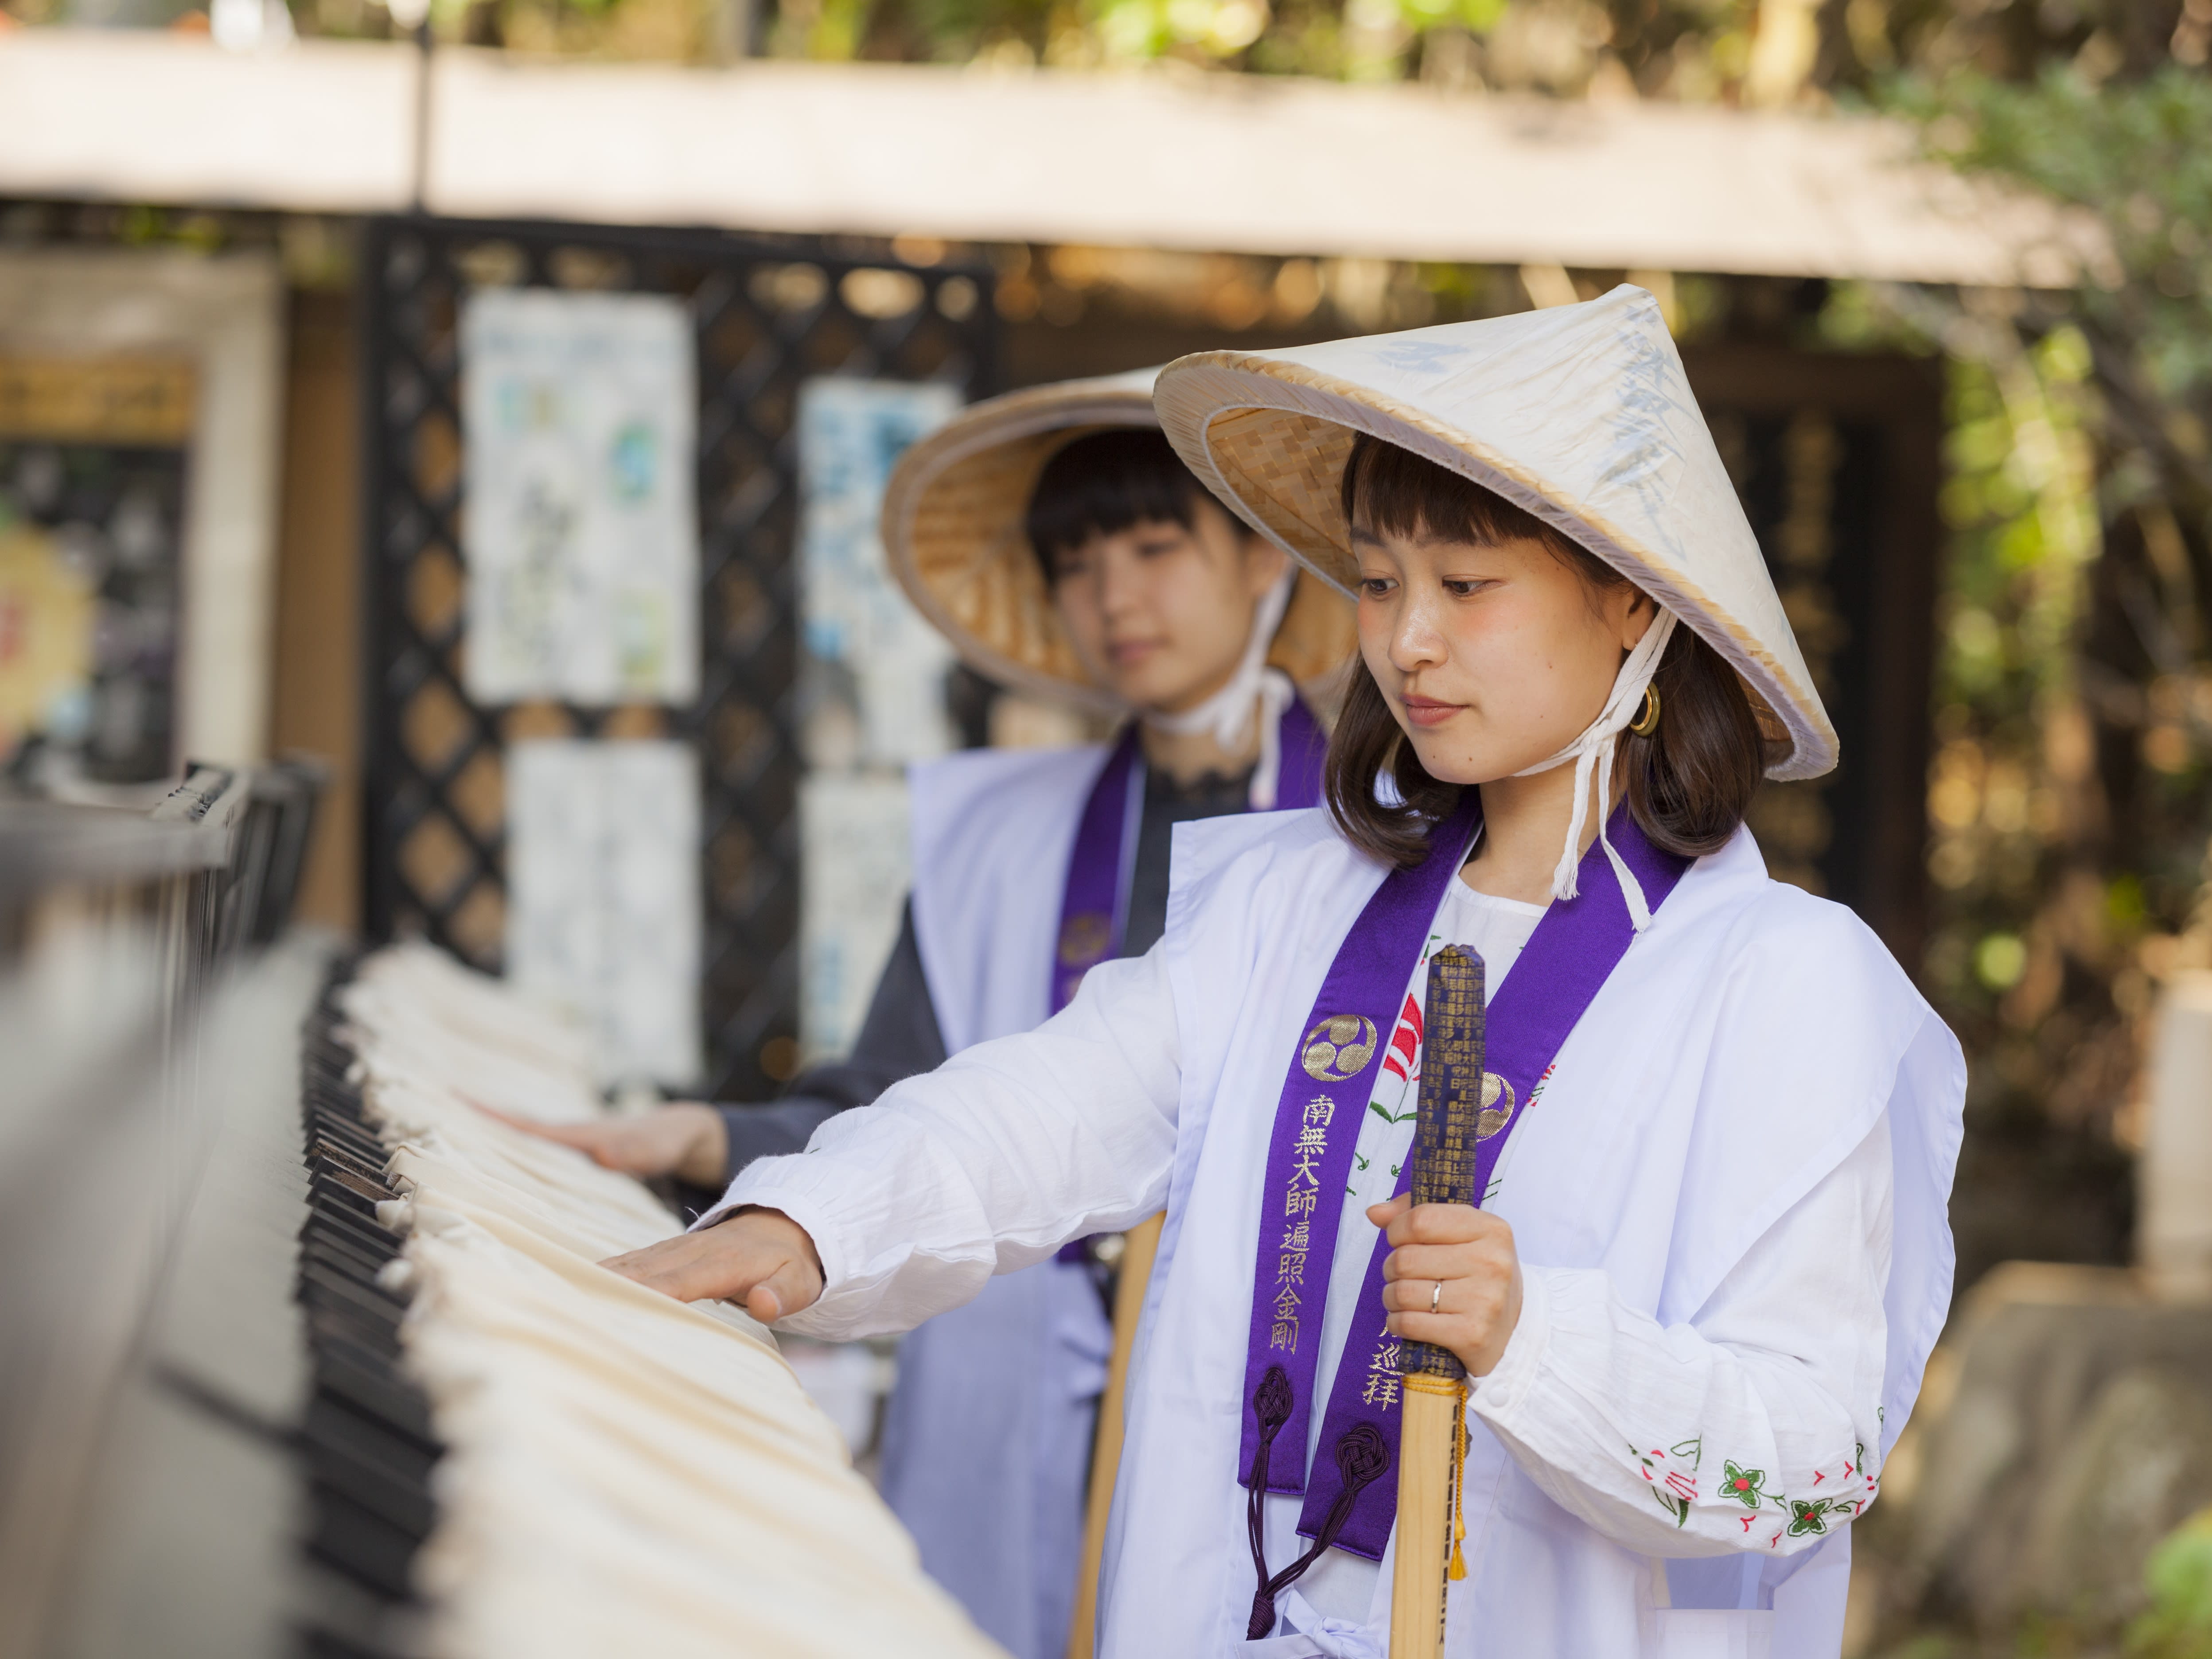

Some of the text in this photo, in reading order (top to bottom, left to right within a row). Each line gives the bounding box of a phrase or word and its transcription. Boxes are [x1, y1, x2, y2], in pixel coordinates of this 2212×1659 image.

[1270, 1094, 1335, 1355] 南無大師遍照金剛
[1362, 1312, 1405, 1411] 巡拝
